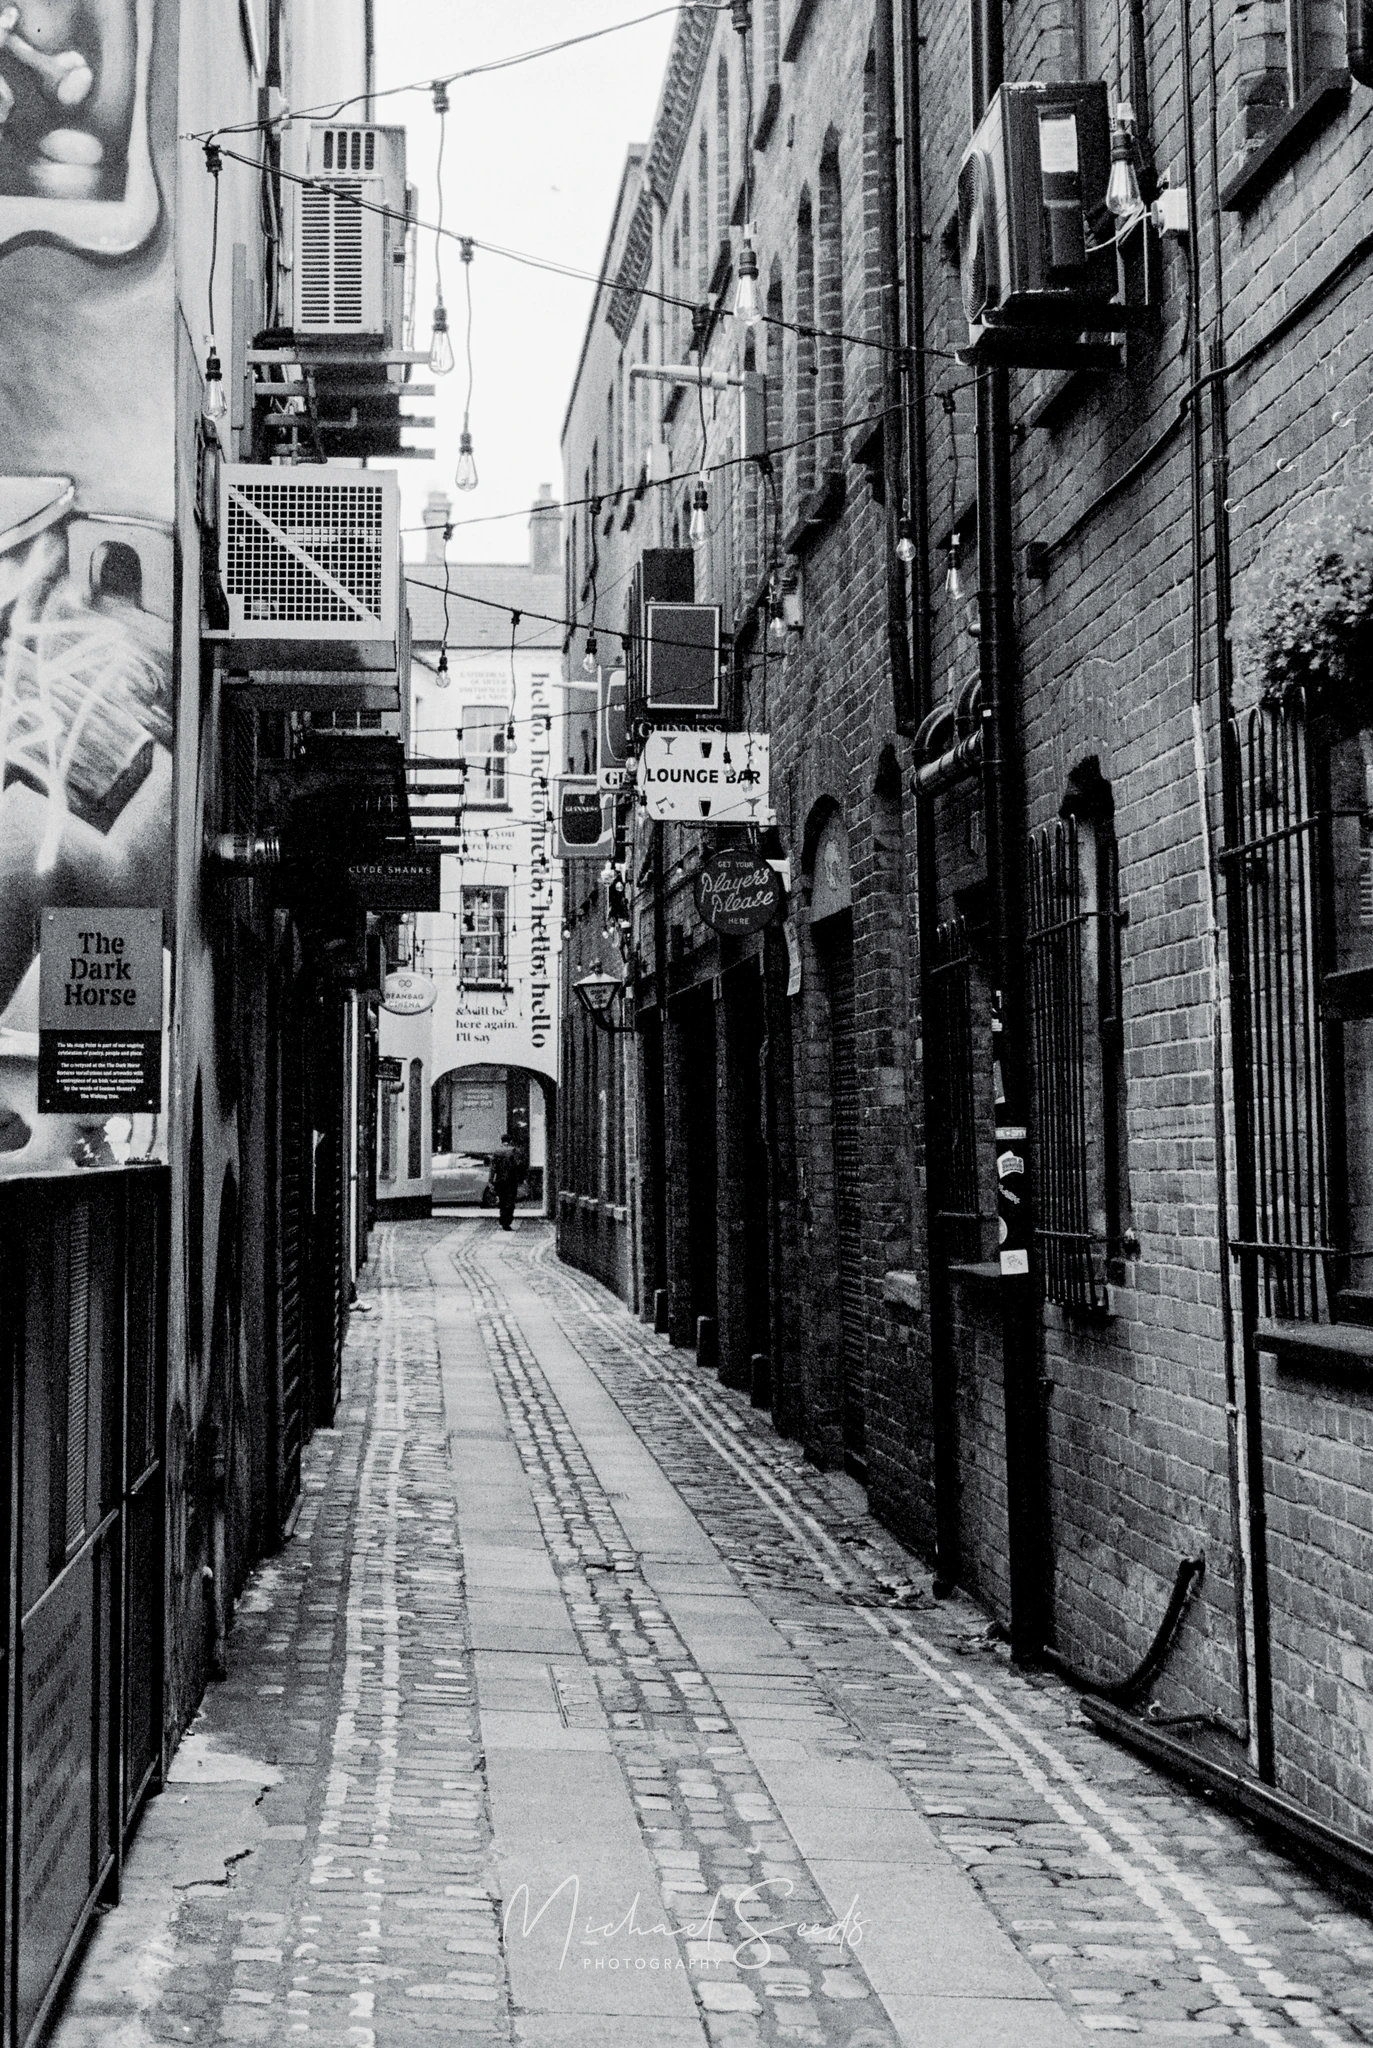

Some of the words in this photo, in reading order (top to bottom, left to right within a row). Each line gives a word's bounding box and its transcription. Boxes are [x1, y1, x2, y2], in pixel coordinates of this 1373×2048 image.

[648, 768, 718, 784] LOUNGE
[726, 770, 760, 784] BAR
[348, 866, 382, 874] CLYDE
[387, 866, 432, 874] SHANKS
[701, 868, 770, 903] Player's
[712, 890, 774, 923] Please
[78, 932, 125, 955] The
[70, 958, 132, 980] Dark
[64, 984, 137, 1006] Horse
[466, 1006, 489, 1016] will
[492, 1006, 506, 1016] be
[531, 983, 550, 1048] hello
[456, 1020, 481, 1028] here
[484, 1020, 518, 1031] again.
[456, 1032, 471, 1041] I'll
[474, 1034, 490, 1044] say
